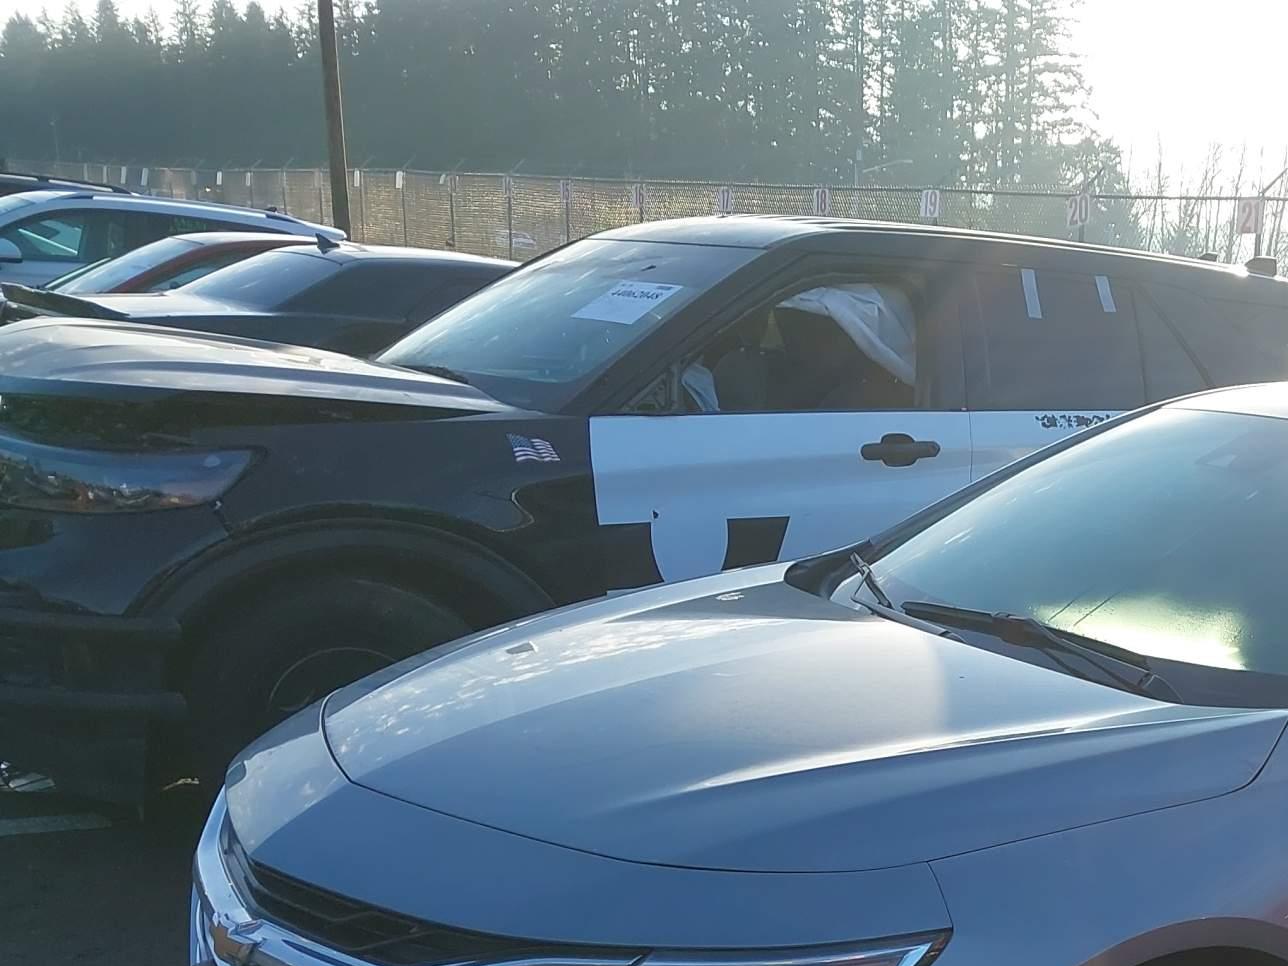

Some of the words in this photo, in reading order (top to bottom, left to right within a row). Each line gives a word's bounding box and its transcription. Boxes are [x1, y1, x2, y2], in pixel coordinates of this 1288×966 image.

[816, 189, 827, 215] 18
[924, 190, 938, 217] 19
[1069, 195, 1089, 226] 20
[1241, 200, 1261, 234] 21
